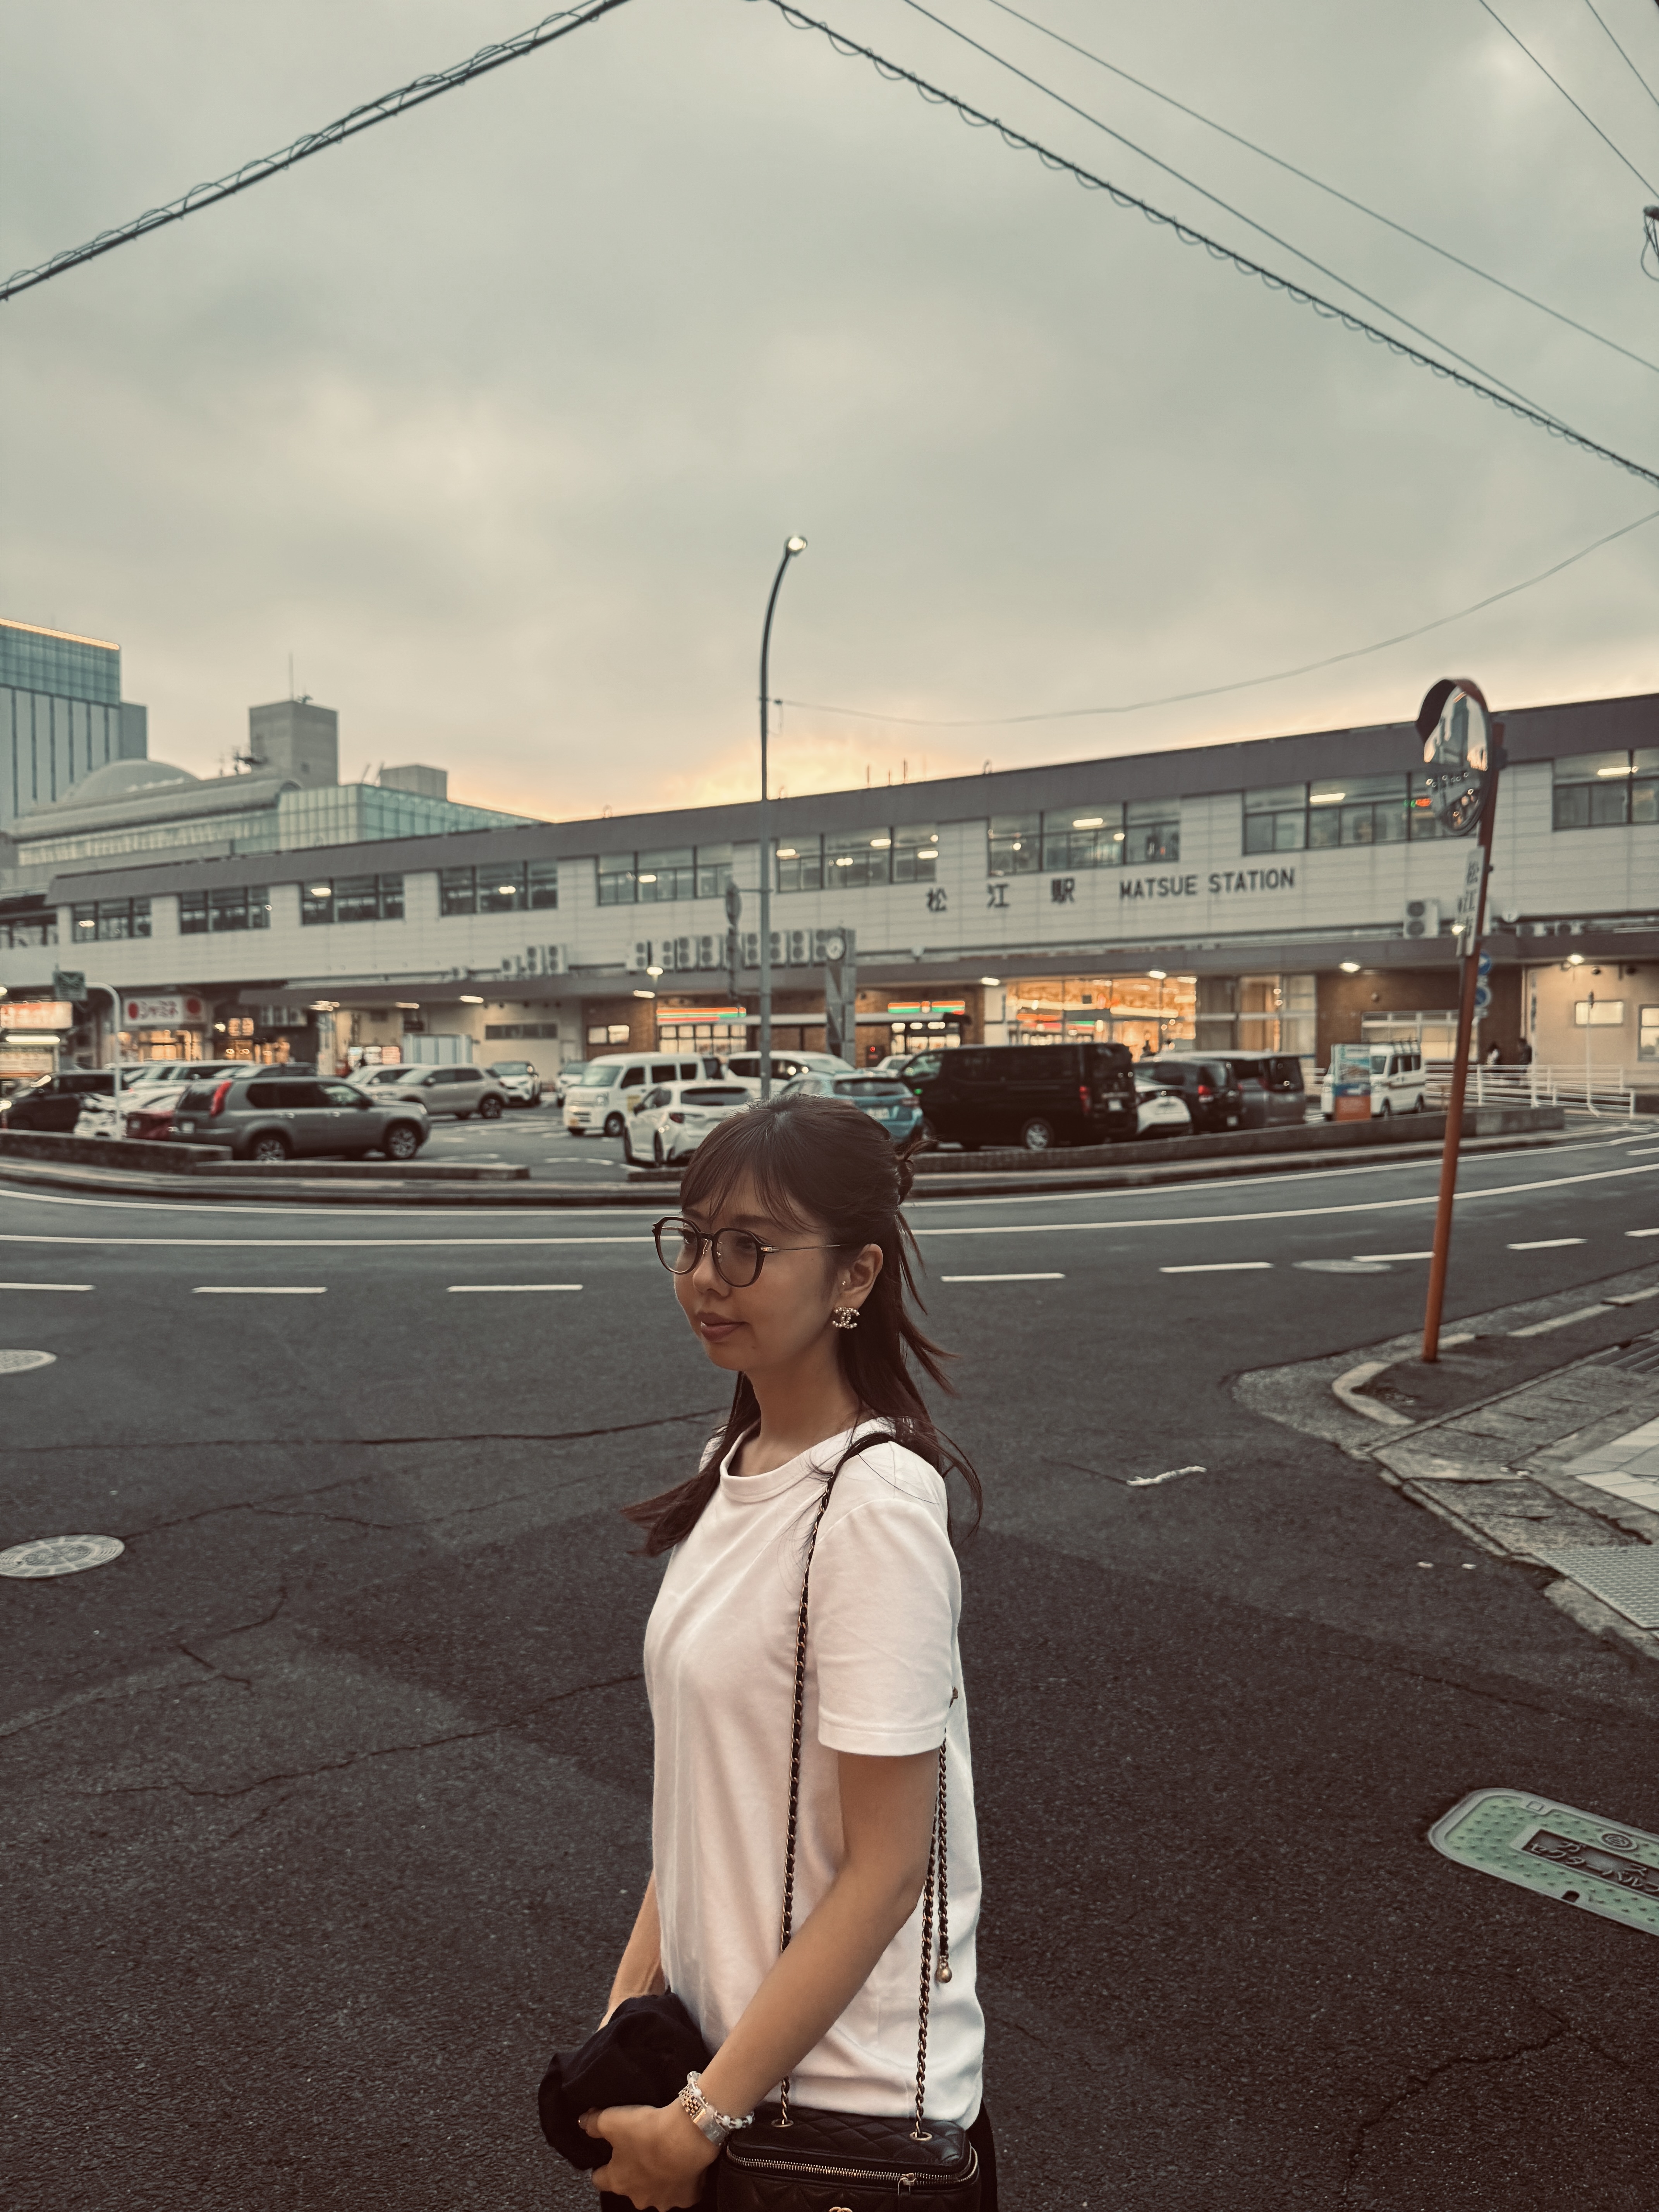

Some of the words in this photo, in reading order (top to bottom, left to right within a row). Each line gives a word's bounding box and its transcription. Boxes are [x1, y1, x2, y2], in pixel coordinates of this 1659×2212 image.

[926, 877, 1075, 912] 松江駅
[1120, 874, 1198, 899] MATSUE
[1208, 867, 1295, 893] STATION
